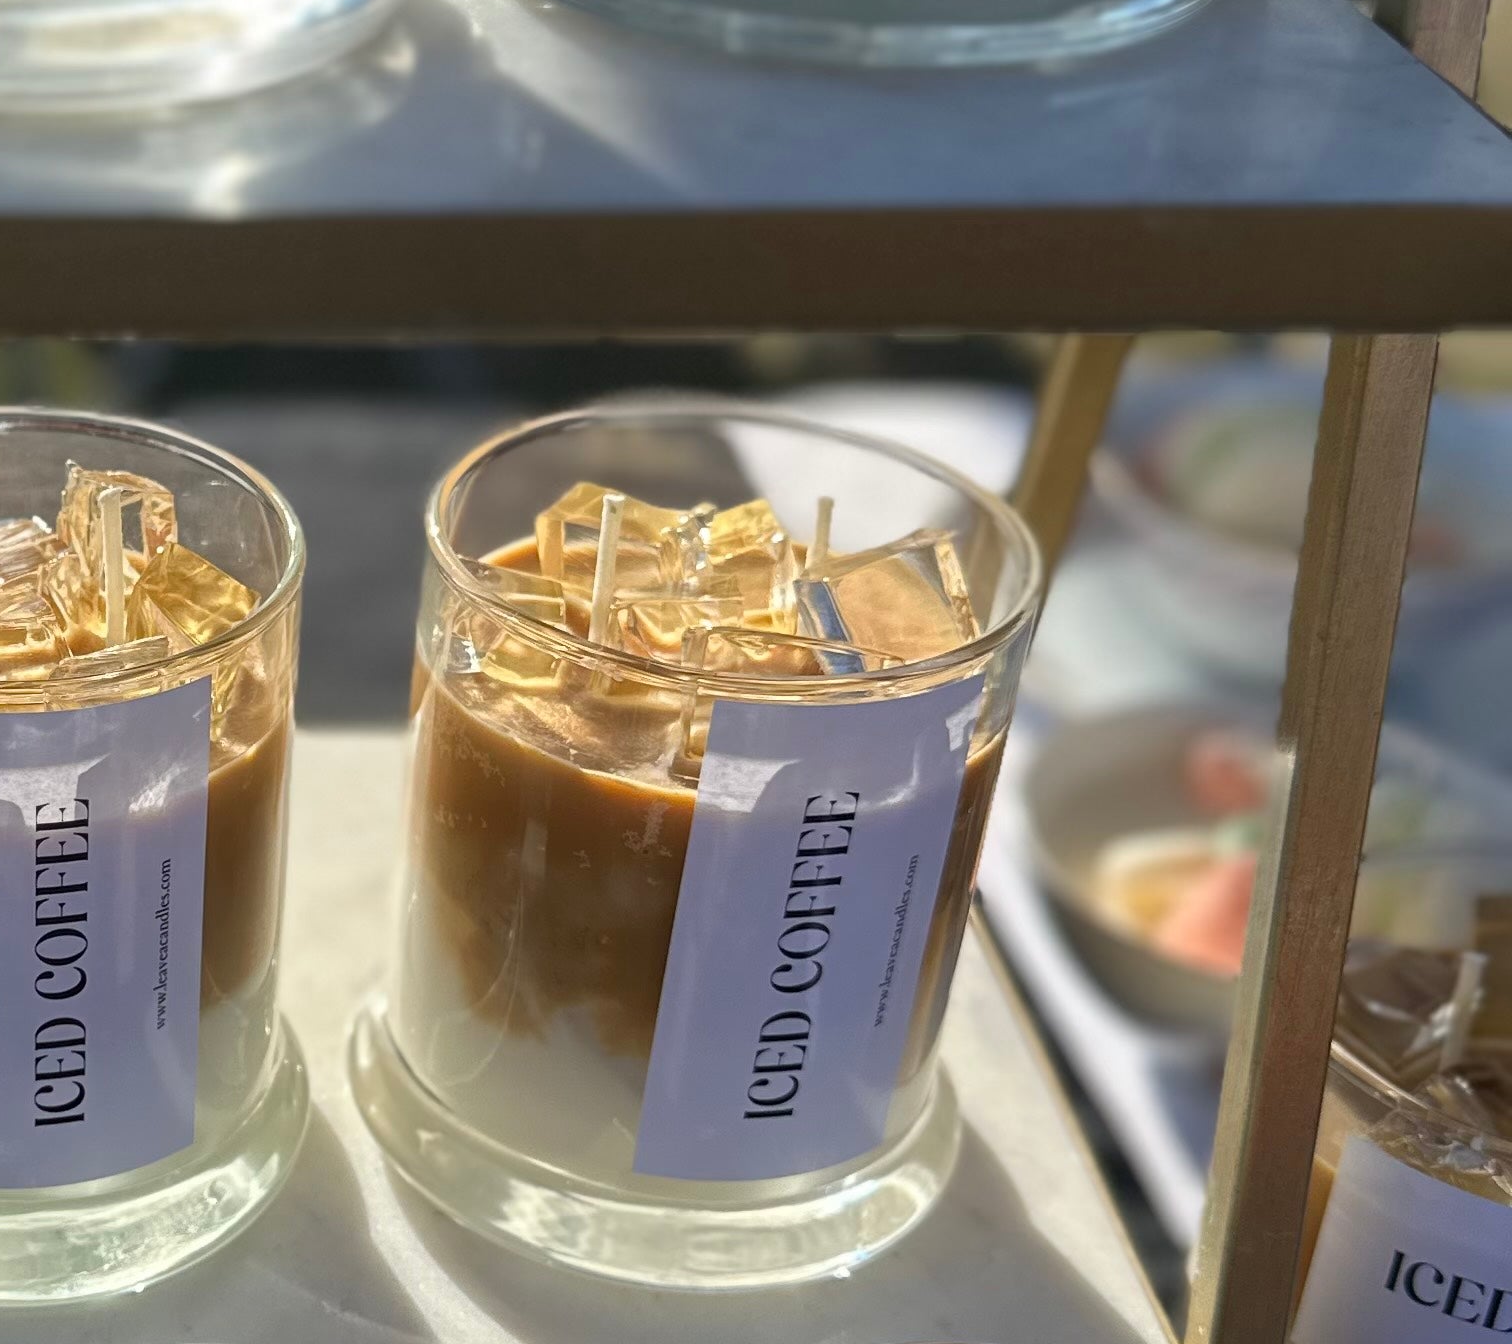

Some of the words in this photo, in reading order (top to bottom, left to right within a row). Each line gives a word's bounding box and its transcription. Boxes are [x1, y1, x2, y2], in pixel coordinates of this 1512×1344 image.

[34, 798, 90, 1000] COFFEE
[153, 858, 171, 1031] www.leaveacandles.com
[770, 791, 860, 994] COFFEE
[34, 1017, 87, 1127] ICED
[744, 1011, 811, 1120] ICED
[1384, 1250, 1512, 1334] ICED
